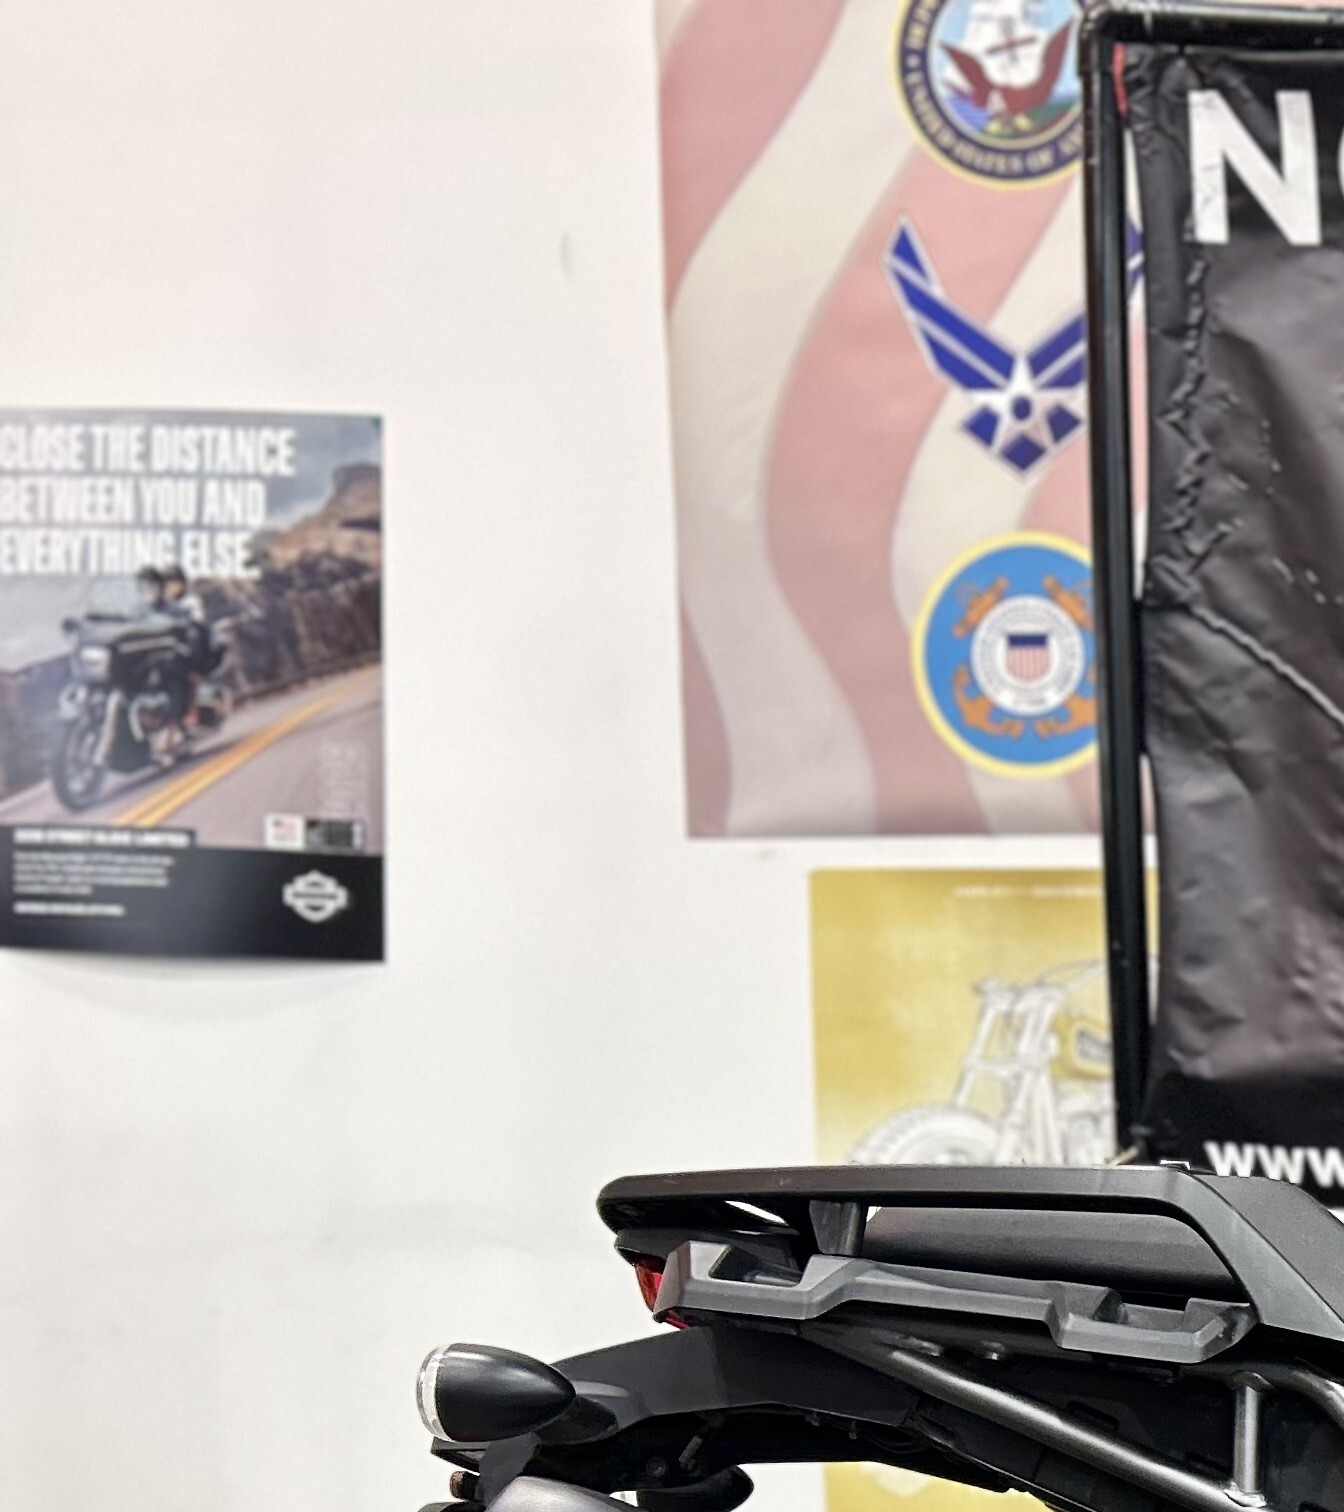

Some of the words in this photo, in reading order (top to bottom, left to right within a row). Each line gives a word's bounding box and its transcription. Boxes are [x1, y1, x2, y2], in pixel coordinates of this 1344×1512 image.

[0, 424, 84, 471] CLOSE
[92, 425, 146, 471] THE
[151, 426, 296, 476] DISTANCE
[0, 476, 135, 523] BETWEEN
[140, 478, 199, 525] YOU
[203, 480, 267, 527] AND
[0, 528, 176, 575] EVERYTHING
[182, 530, 262, 579] ELSE.
